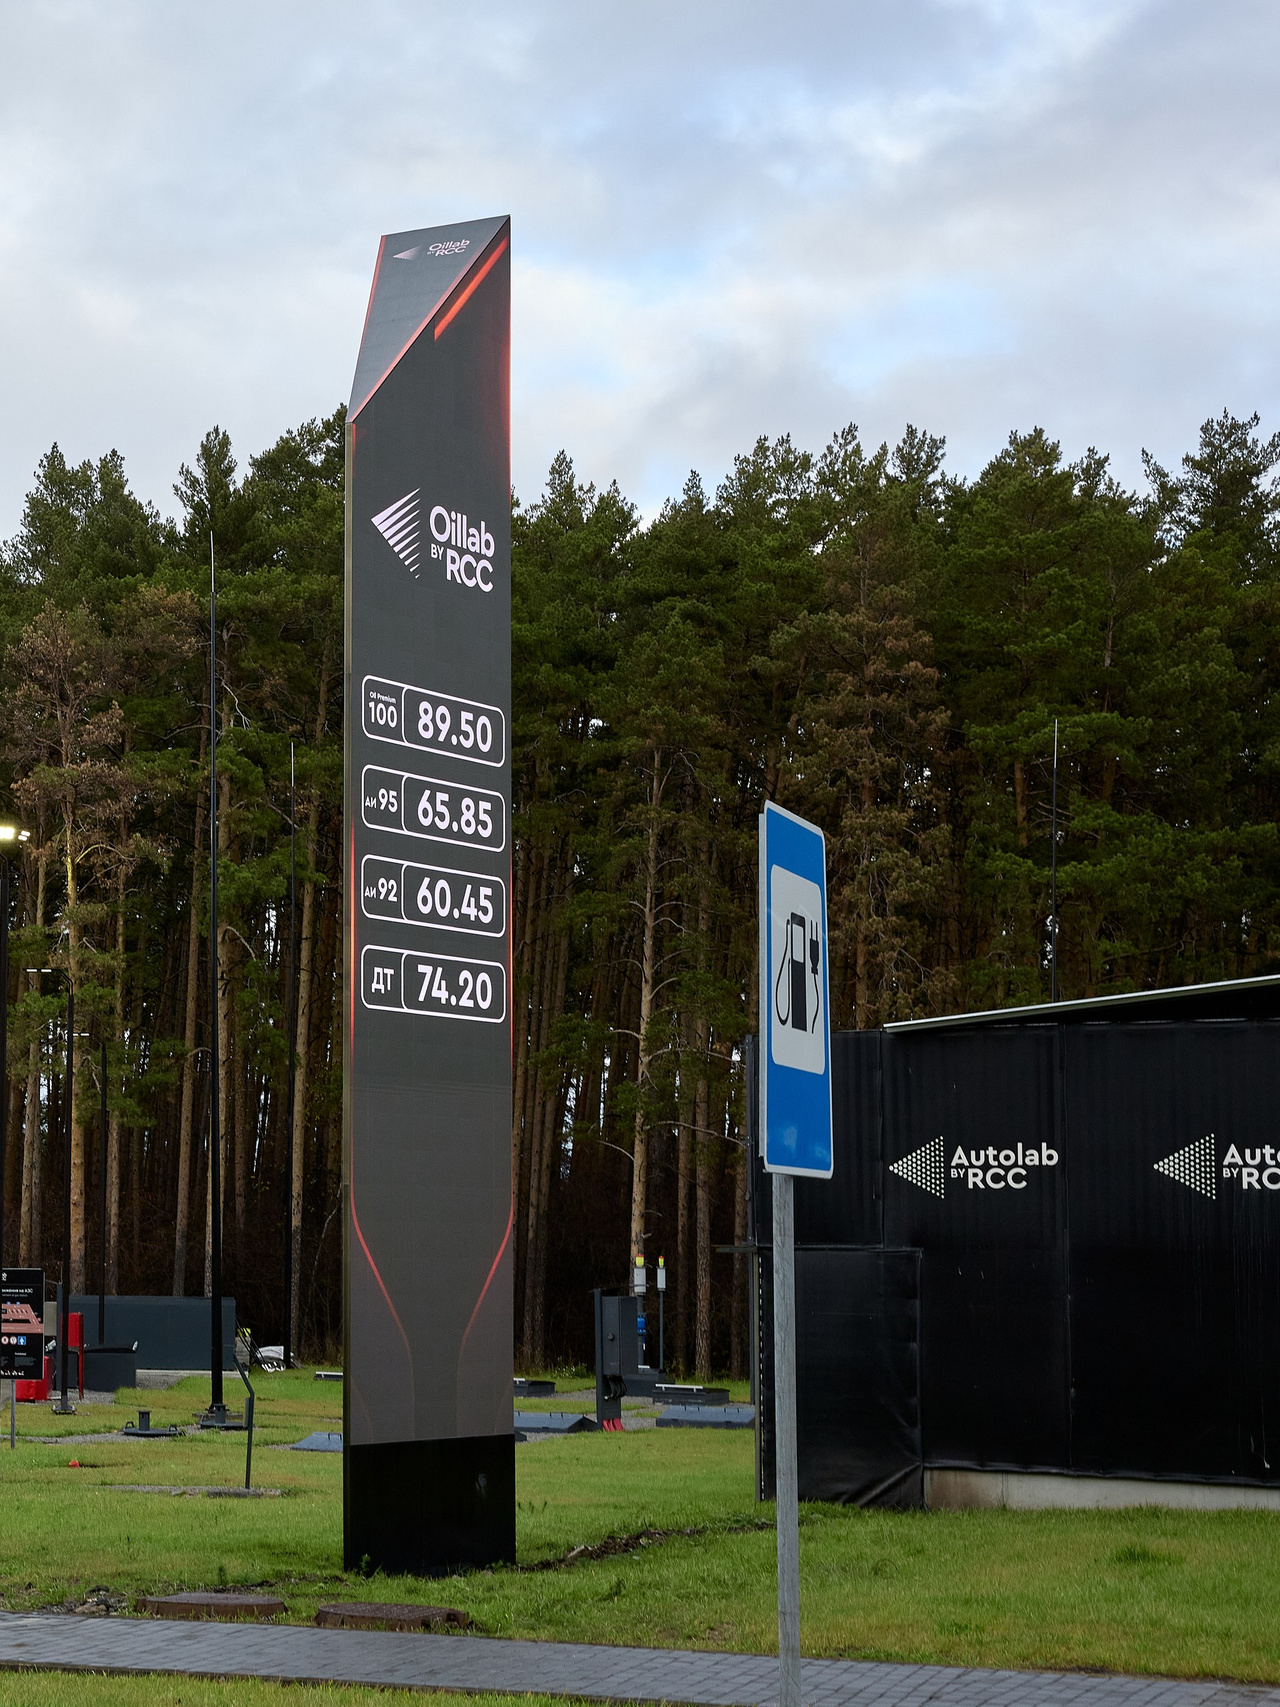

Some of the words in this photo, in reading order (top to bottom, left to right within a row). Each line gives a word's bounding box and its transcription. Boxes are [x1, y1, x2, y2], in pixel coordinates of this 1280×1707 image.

[429, 238, 470, 251] Oillab
[435, 245, 467, 257] RCC
[429, 505, 495, 558] Oillab
[430, 543, 444, 560] BY
[446, 548, 494, 593] RCC
[377, 692, 397, 704] Premium
[368, 701, 398, 728] 100
[418, 700, 493, 753] 89.50
[364, 796, 377, 809] АИ
[378, 788, 398, 813] 95
[417, 789, 493, 838] 65.85
[364, 886, 377, 899] АИ
[378, 877, 398, 902] 92
[417, 876, 493, 924] 60.45
[371, 966, 395, 994] ДТ
[417, 964, 493, 1010] 74.20
[950, 1142, 1059, 1167] Autolab
[1222, 1143, 1280, 1166] Aut
[950, 1168, 966, 1178] BY
[967, 1167, 1028, 1190] RCC
[1222, 1167, 1239, 1178] BY
